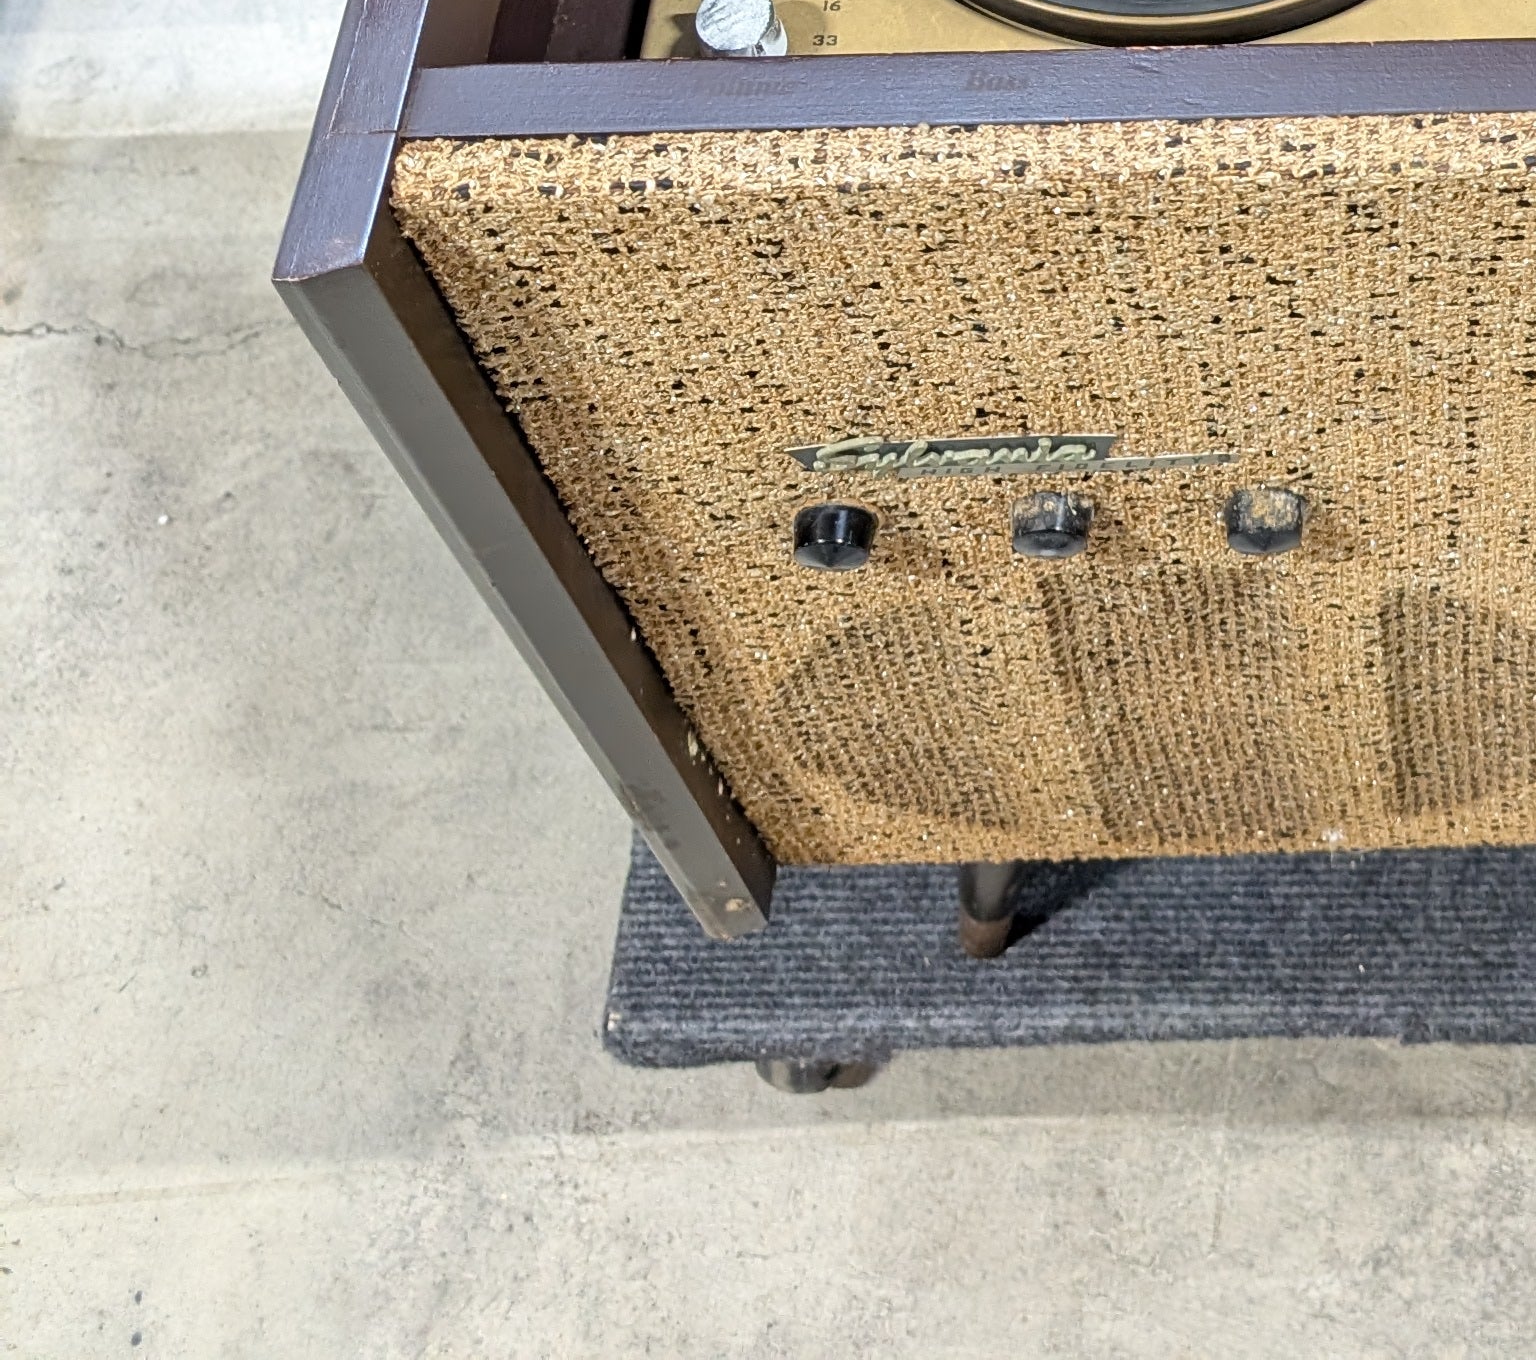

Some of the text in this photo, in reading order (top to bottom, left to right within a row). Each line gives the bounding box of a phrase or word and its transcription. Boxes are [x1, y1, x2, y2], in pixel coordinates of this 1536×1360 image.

[823, 0, 841, 11] 16
[812, 34, 838, 46] 33
[813, 436, 1097, 478] Sylvania
[920, 466, 1001, 476] HIGH
